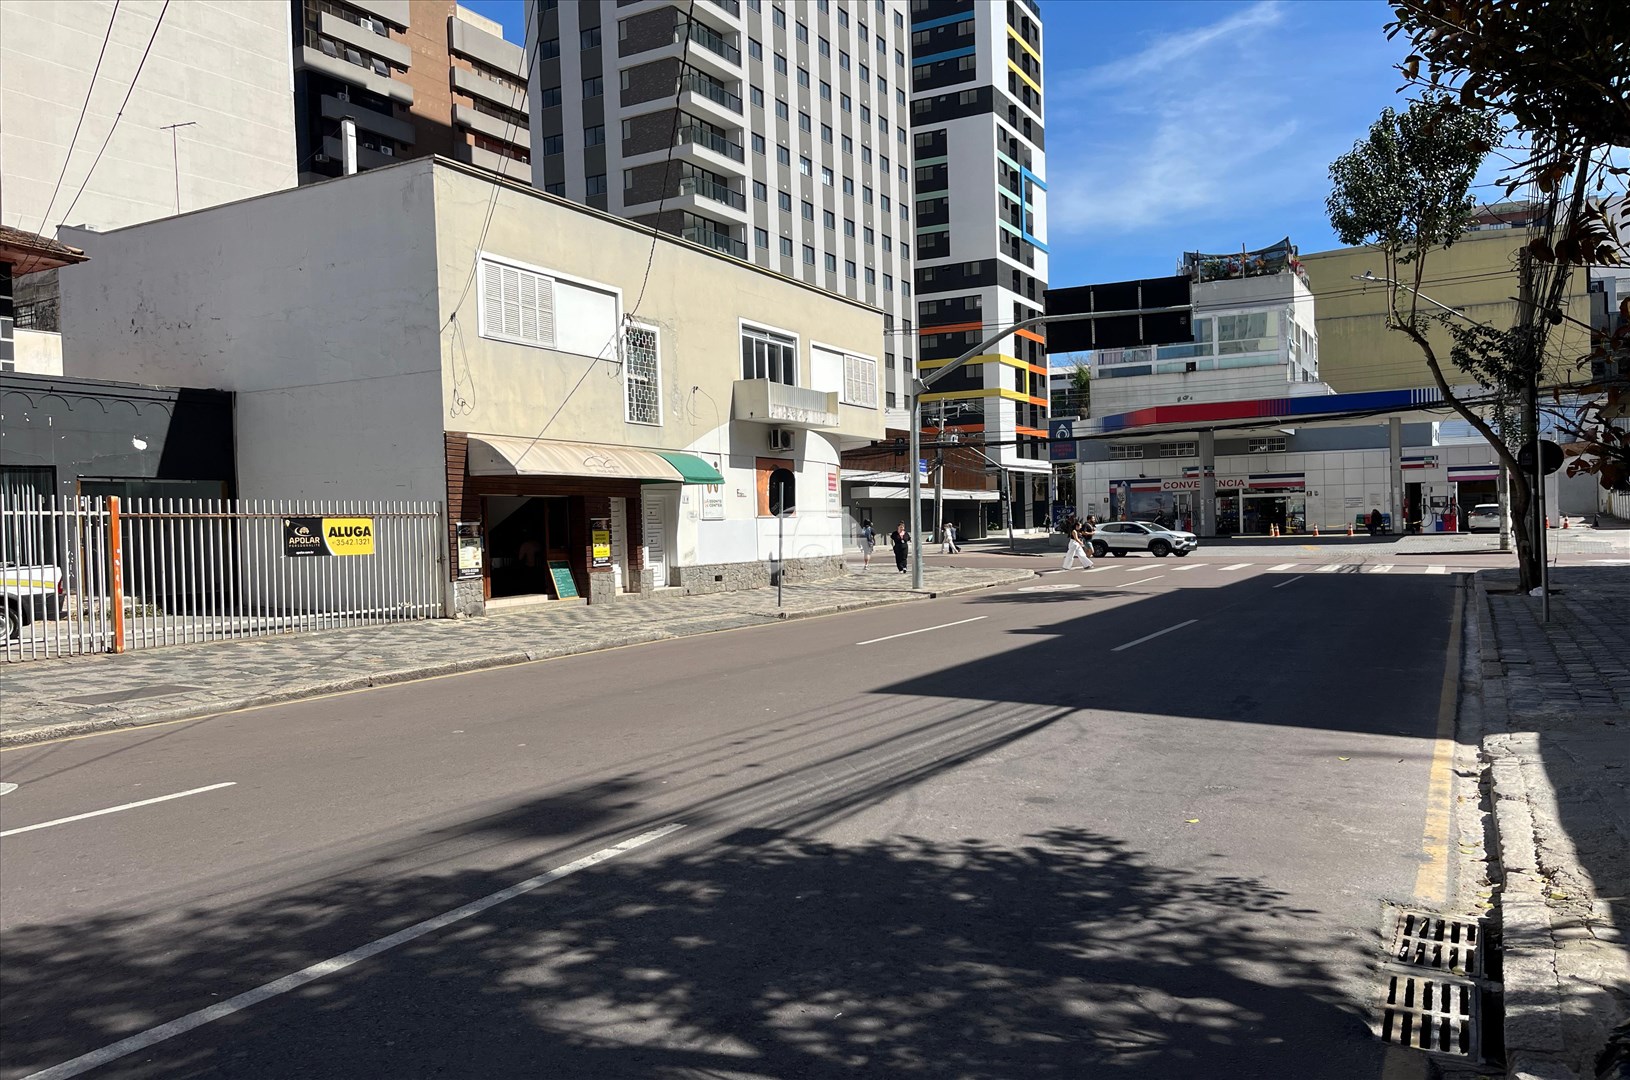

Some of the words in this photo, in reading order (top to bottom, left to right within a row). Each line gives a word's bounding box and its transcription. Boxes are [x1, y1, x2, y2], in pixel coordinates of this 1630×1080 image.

[1163, 479, 1245, 489] CONVENCIA
[328, 525, 372, 538] ALUGA
[289, 536, 320, 544] APOLAR
